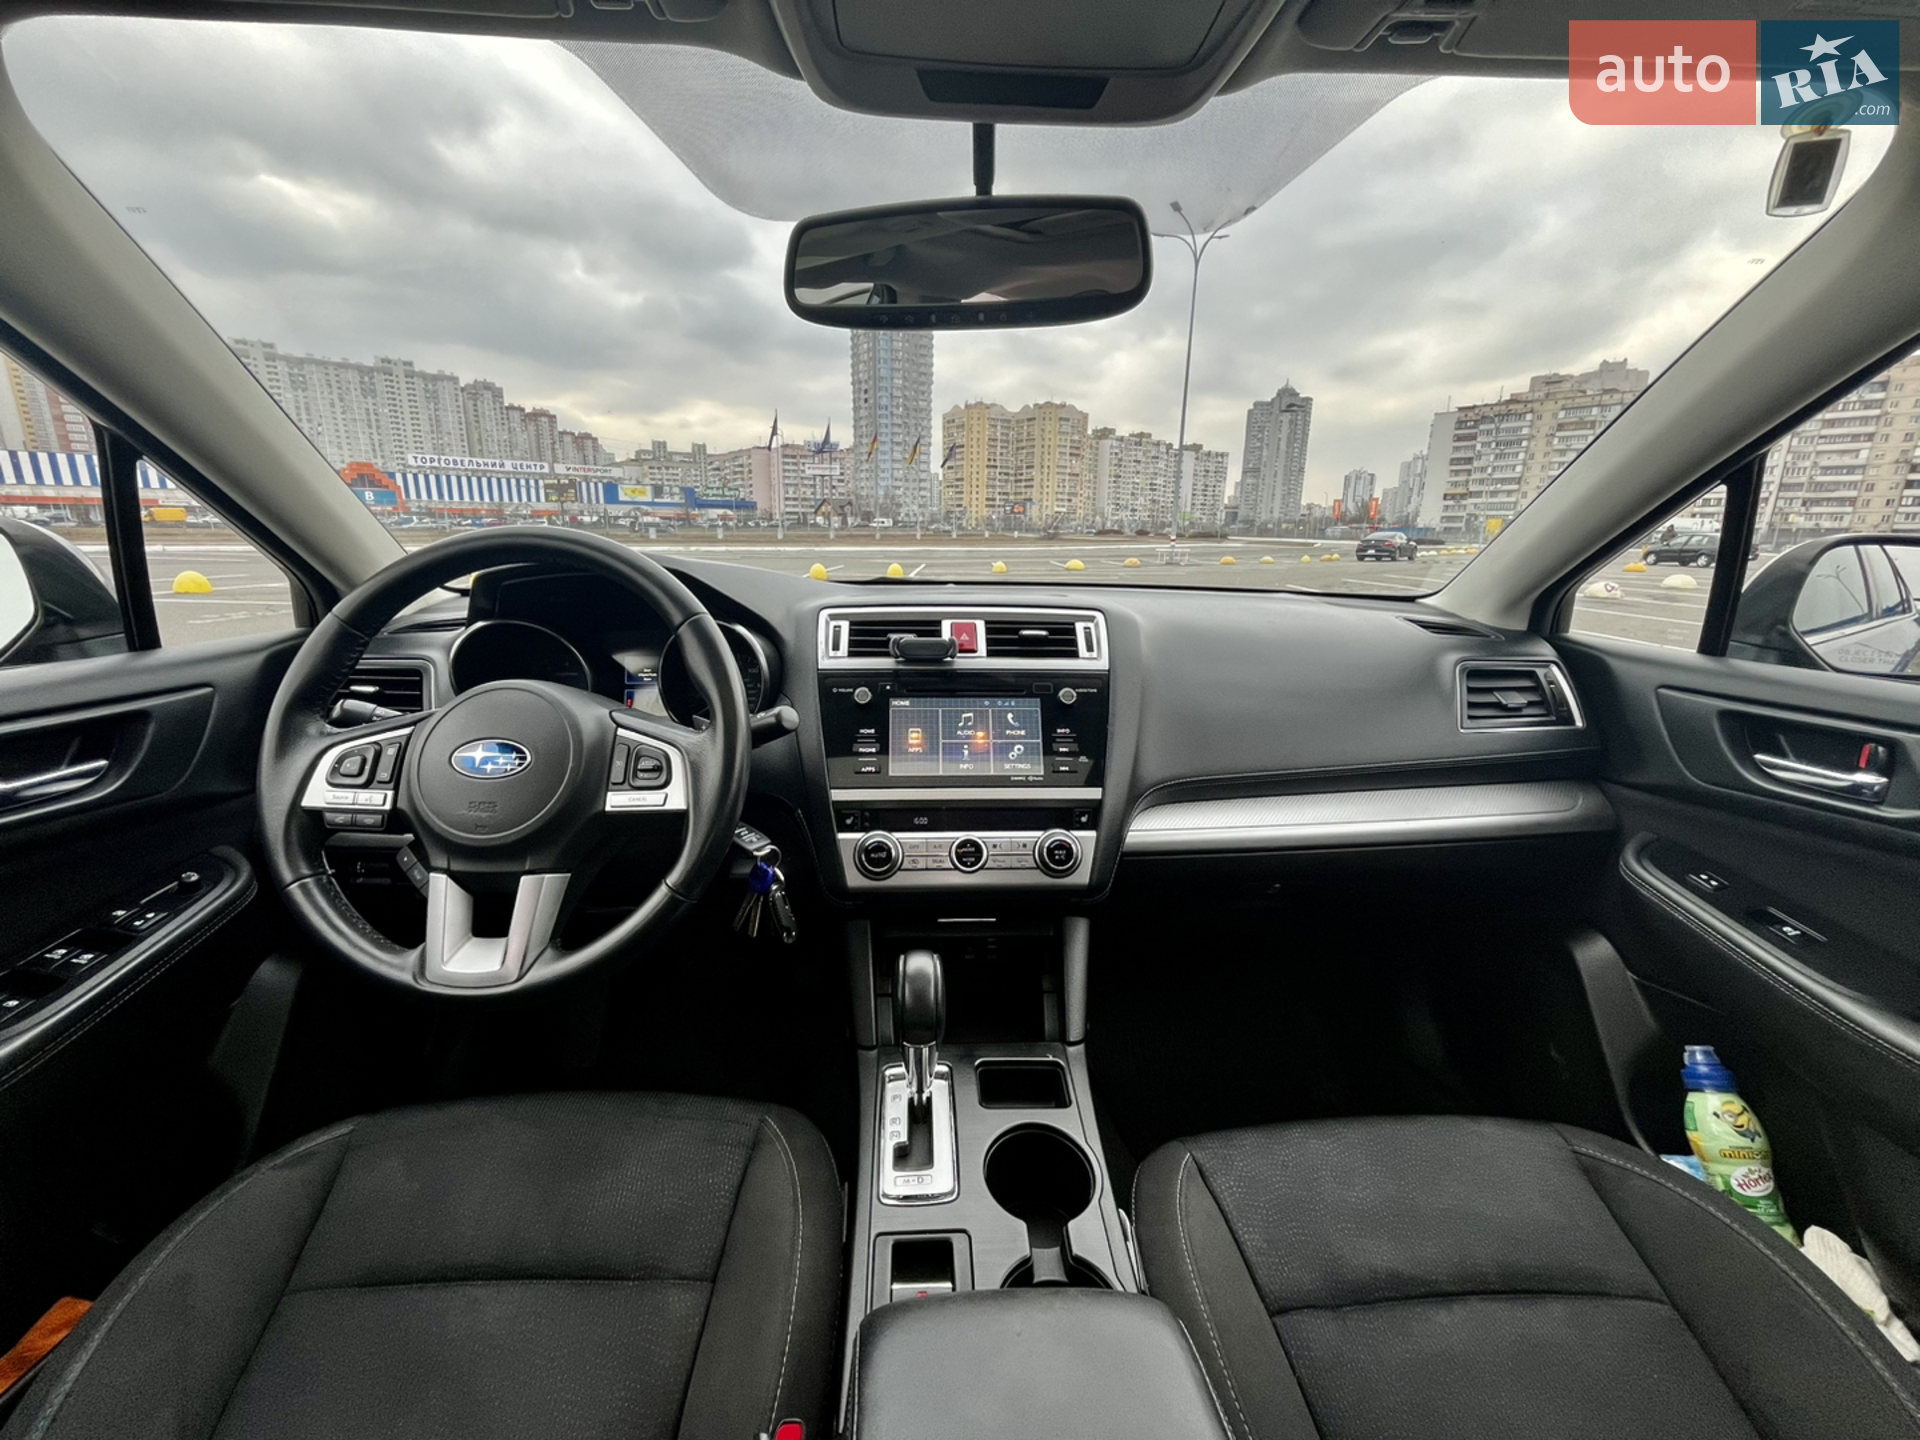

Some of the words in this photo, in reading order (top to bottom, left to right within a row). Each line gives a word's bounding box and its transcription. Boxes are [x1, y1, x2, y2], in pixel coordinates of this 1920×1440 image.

[511, 461, 546, 471] ЦЕНТР
[571, 465, 612, 474] INTERSPORT
[1838, 655, 1876, 665] CLOSER
